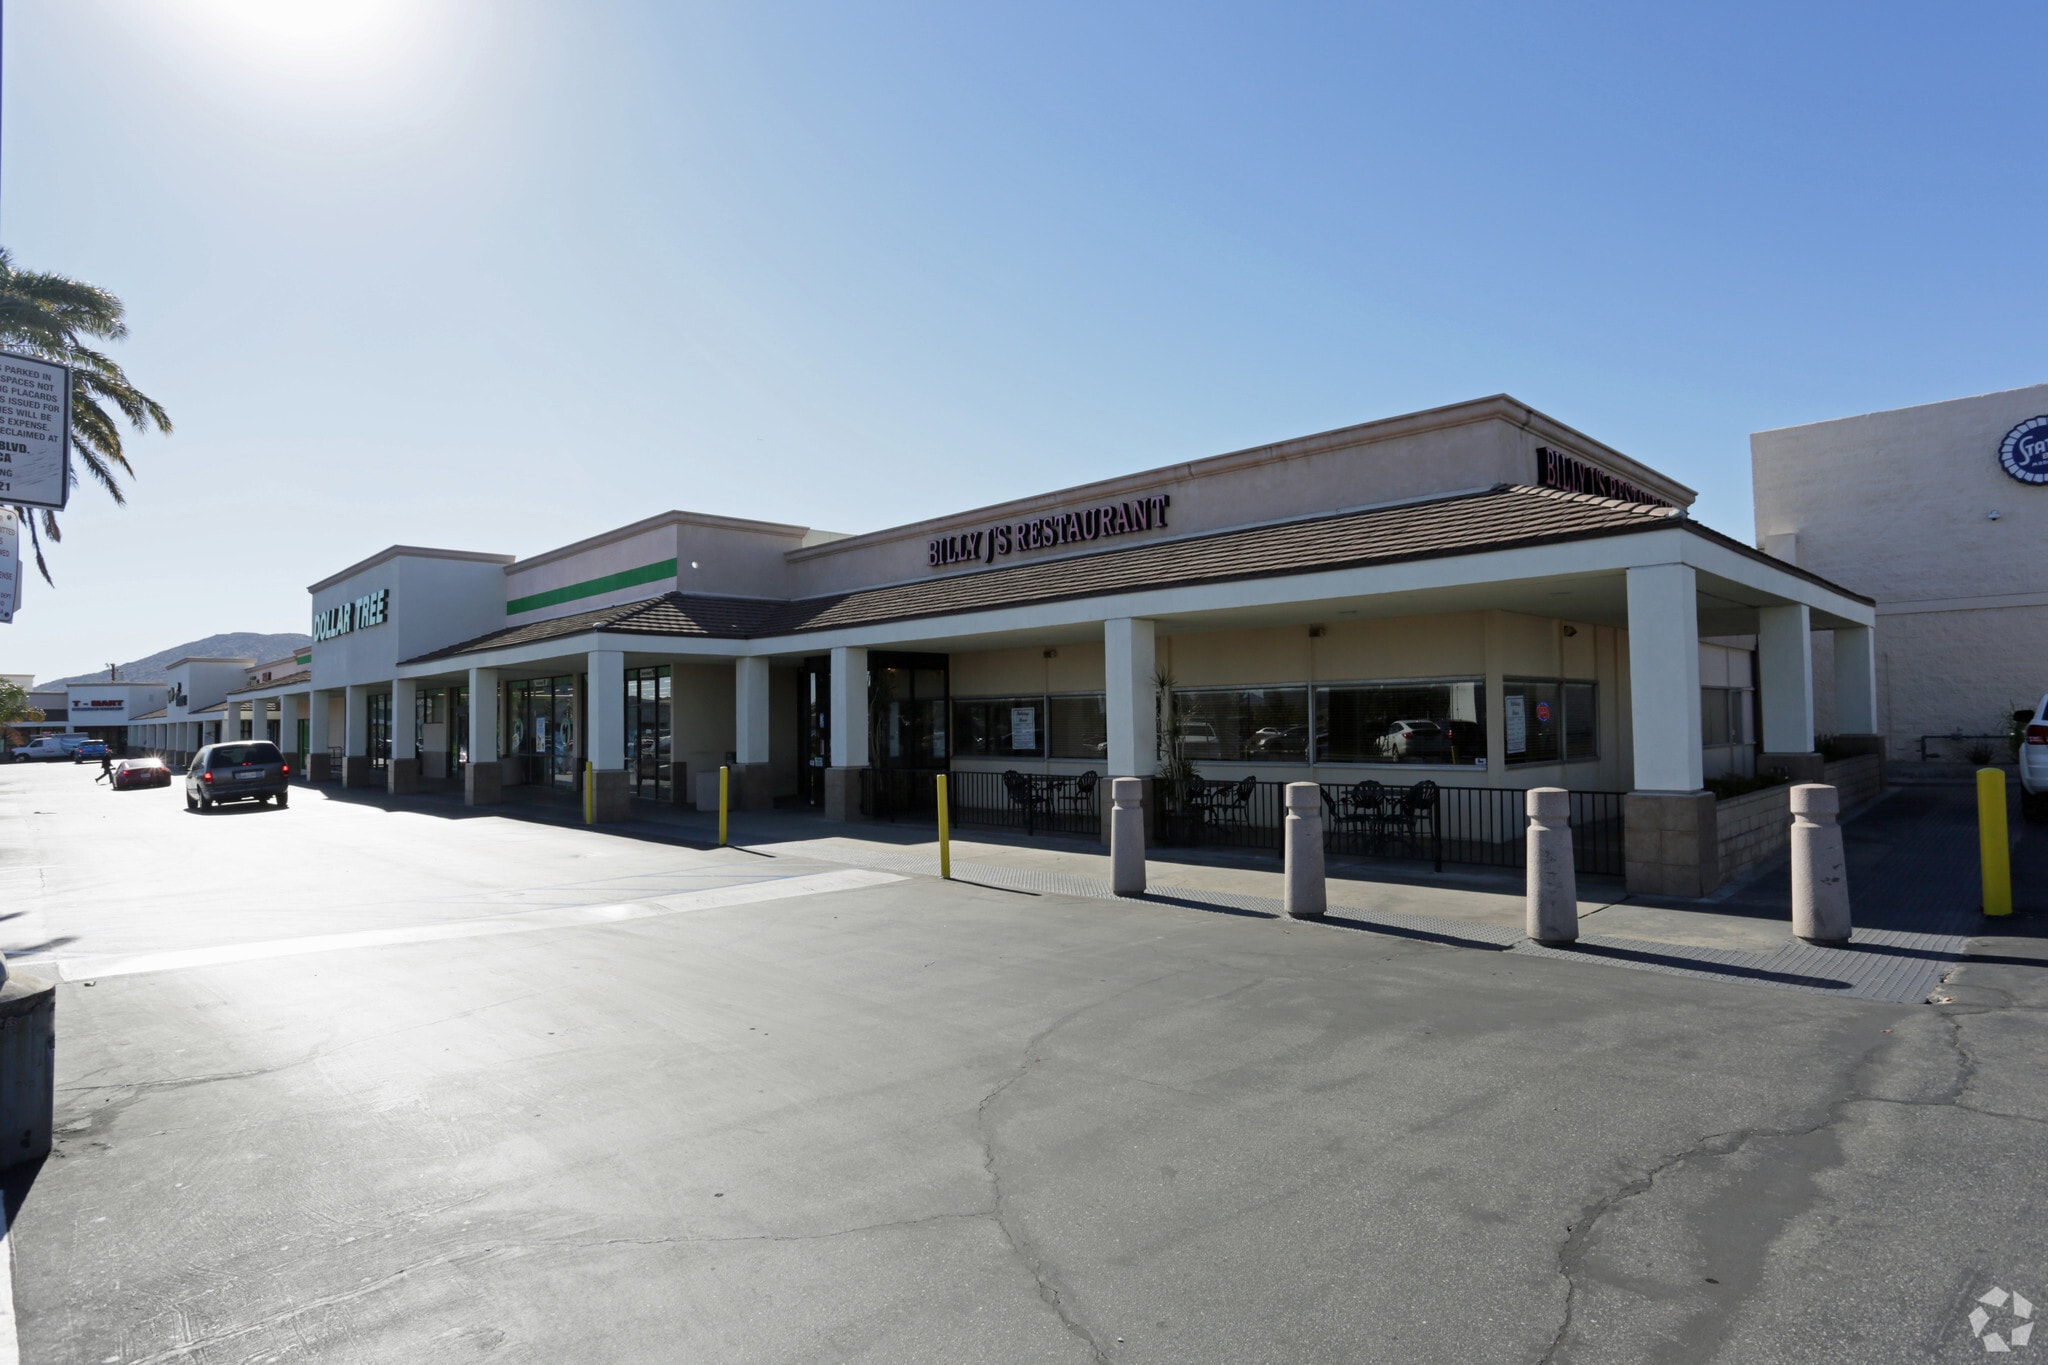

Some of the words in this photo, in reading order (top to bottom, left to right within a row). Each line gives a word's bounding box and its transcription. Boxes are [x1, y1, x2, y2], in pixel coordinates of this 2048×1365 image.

[5, 365, 40, 379] PARKED
[42, 373, 51, 381] IN
[0, 374, 35, 388] SPACES
[37, 382, 54, 392] NOT
[11, 388, 58, 403] PLACARDS
[9, 397, 40, 410] ISSUED
[43, 403, 60, 413] FOR
[16, 409, 37, 419] WILL
[41, 413, 52, 422] BE
[8, 418, 50, 431] EXPENSE.
[0, 440, 30, 454] BLVD.
[928, 532, 982, 567] BILLY
[985, 525, 1012, 563] J'S
[1013, 494, 1170, 552] RESTAURANT
[314, 602, 354, 642] DOLLAR
[355, 589, 390, 630] TREE
